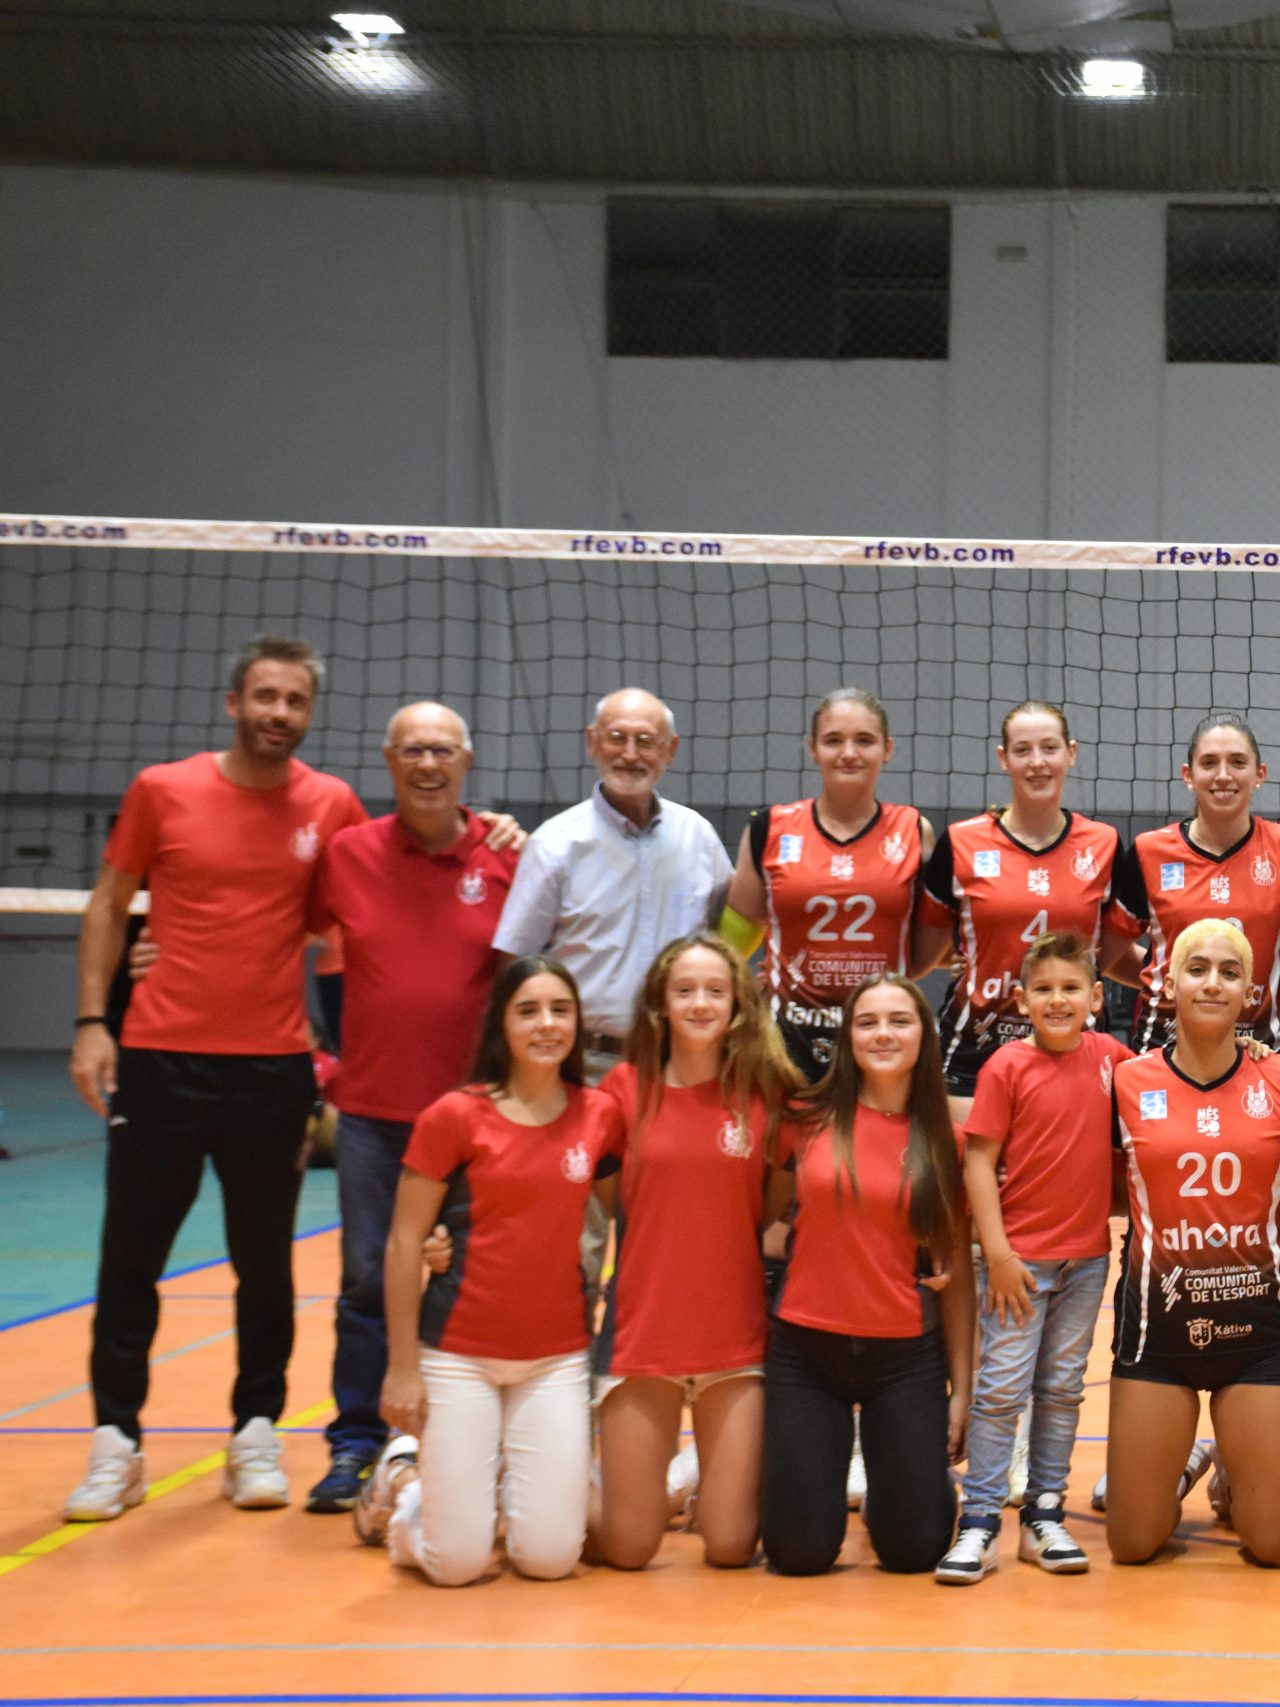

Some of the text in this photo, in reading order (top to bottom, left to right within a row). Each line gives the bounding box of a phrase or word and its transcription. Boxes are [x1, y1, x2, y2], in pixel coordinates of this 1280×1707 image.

[273, 527, 428, 550] rfevb.com
[570, 534, 724, 556] rfevb.com
[864, 541, 1016, 563] rfevb.com
[805, 894, 877, 942] 22
[1020, 909, 1048, 943] 4
[808, 960, 887, 973] COMUNITAT
[813, 974, 829, 986] DE
[785, 1001, 843, 1028] famil
[1177, 1151, 1242, 1198] 20
[1162, 1218, 1261, 1251] ahora
[1184, 1271, 1261, 1291] COMUNITAT
[1185, 1266, 1223, 1277] Comunitat
[1191, 1282, 1271, 1303] DE L'ESPORT
